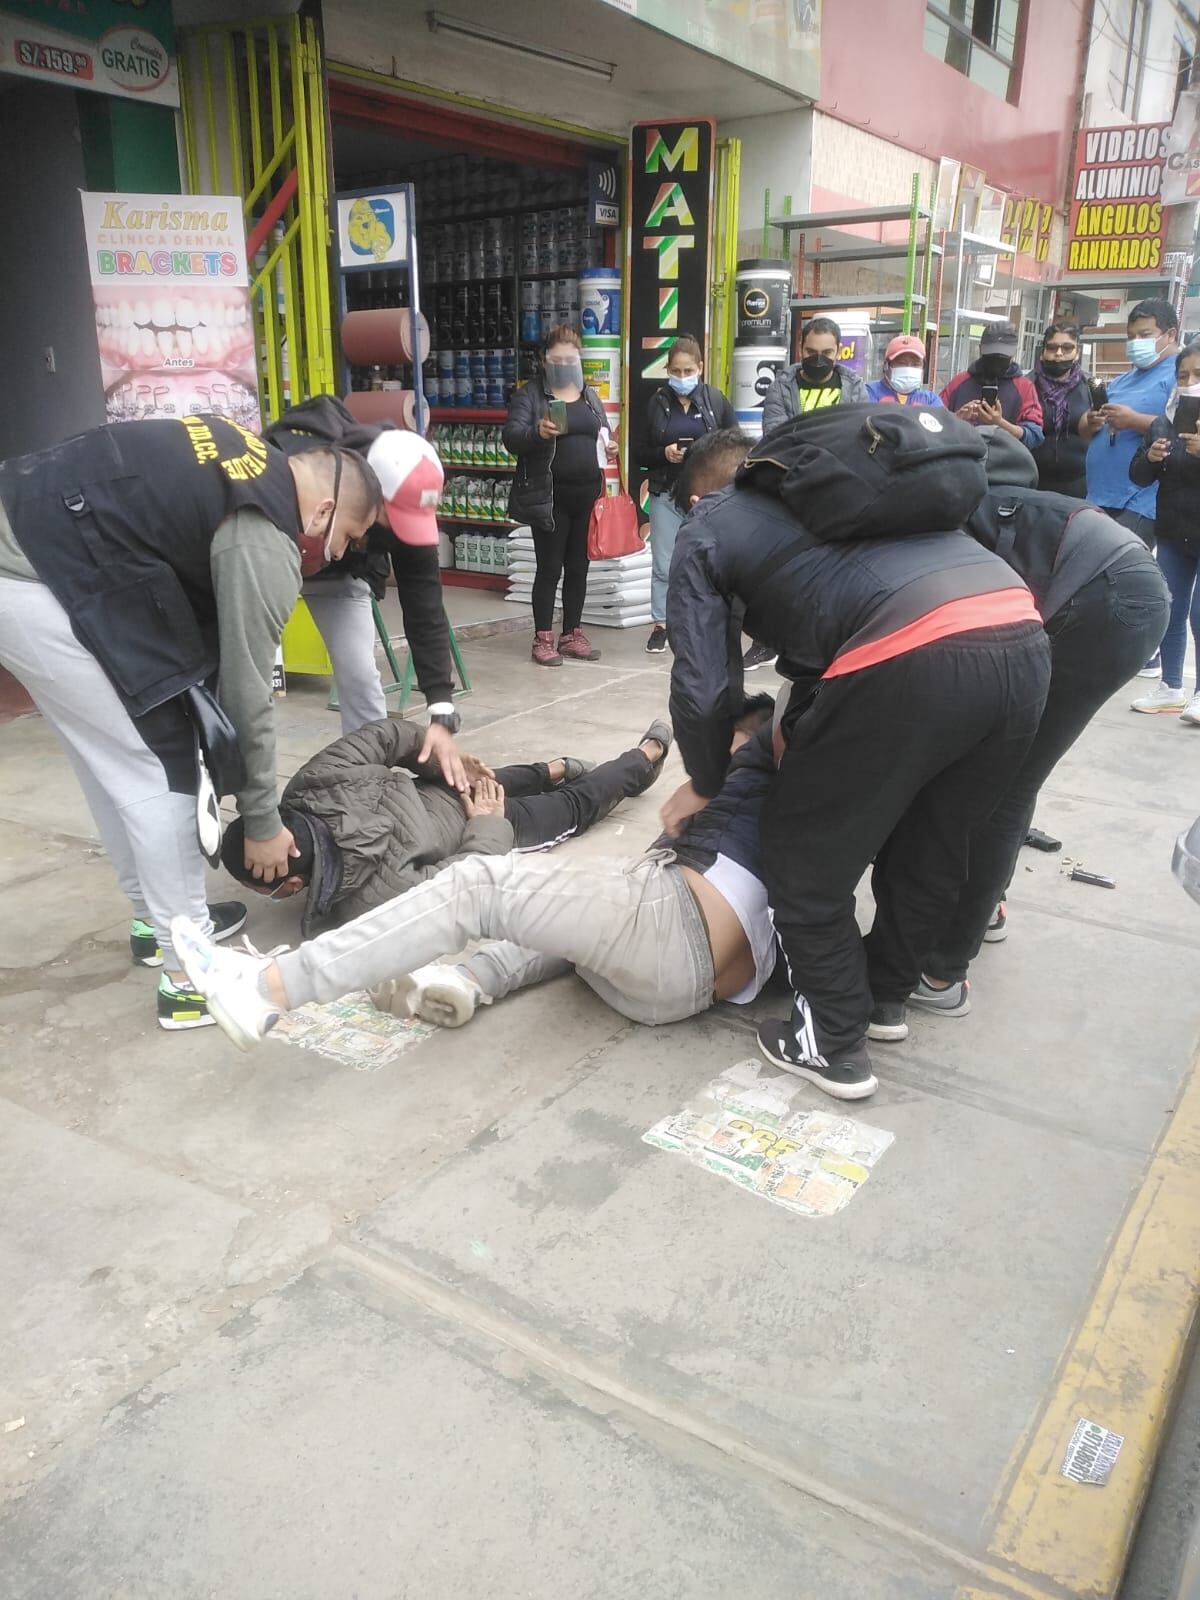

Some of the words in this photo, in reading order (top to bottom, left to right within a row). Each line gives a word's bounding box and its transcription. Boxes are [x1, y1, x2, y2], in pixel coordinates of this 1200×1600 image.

[102, 49, 160, 79] GRATIS
[1085, 127, 1170, 164] VIDRIOS
[101, 201, 228, 231] Karisma
[599, 207, 616, 218] VISA
[1076, 201, 1163, 236] ÁNGULOS
[173, 235, 235, 247] DENTAL
[1068, 237, 1161, 270] RANURADOS
[97, 250, 237, 277] BRACKETS
[164, 357, 194, 367] Antes
